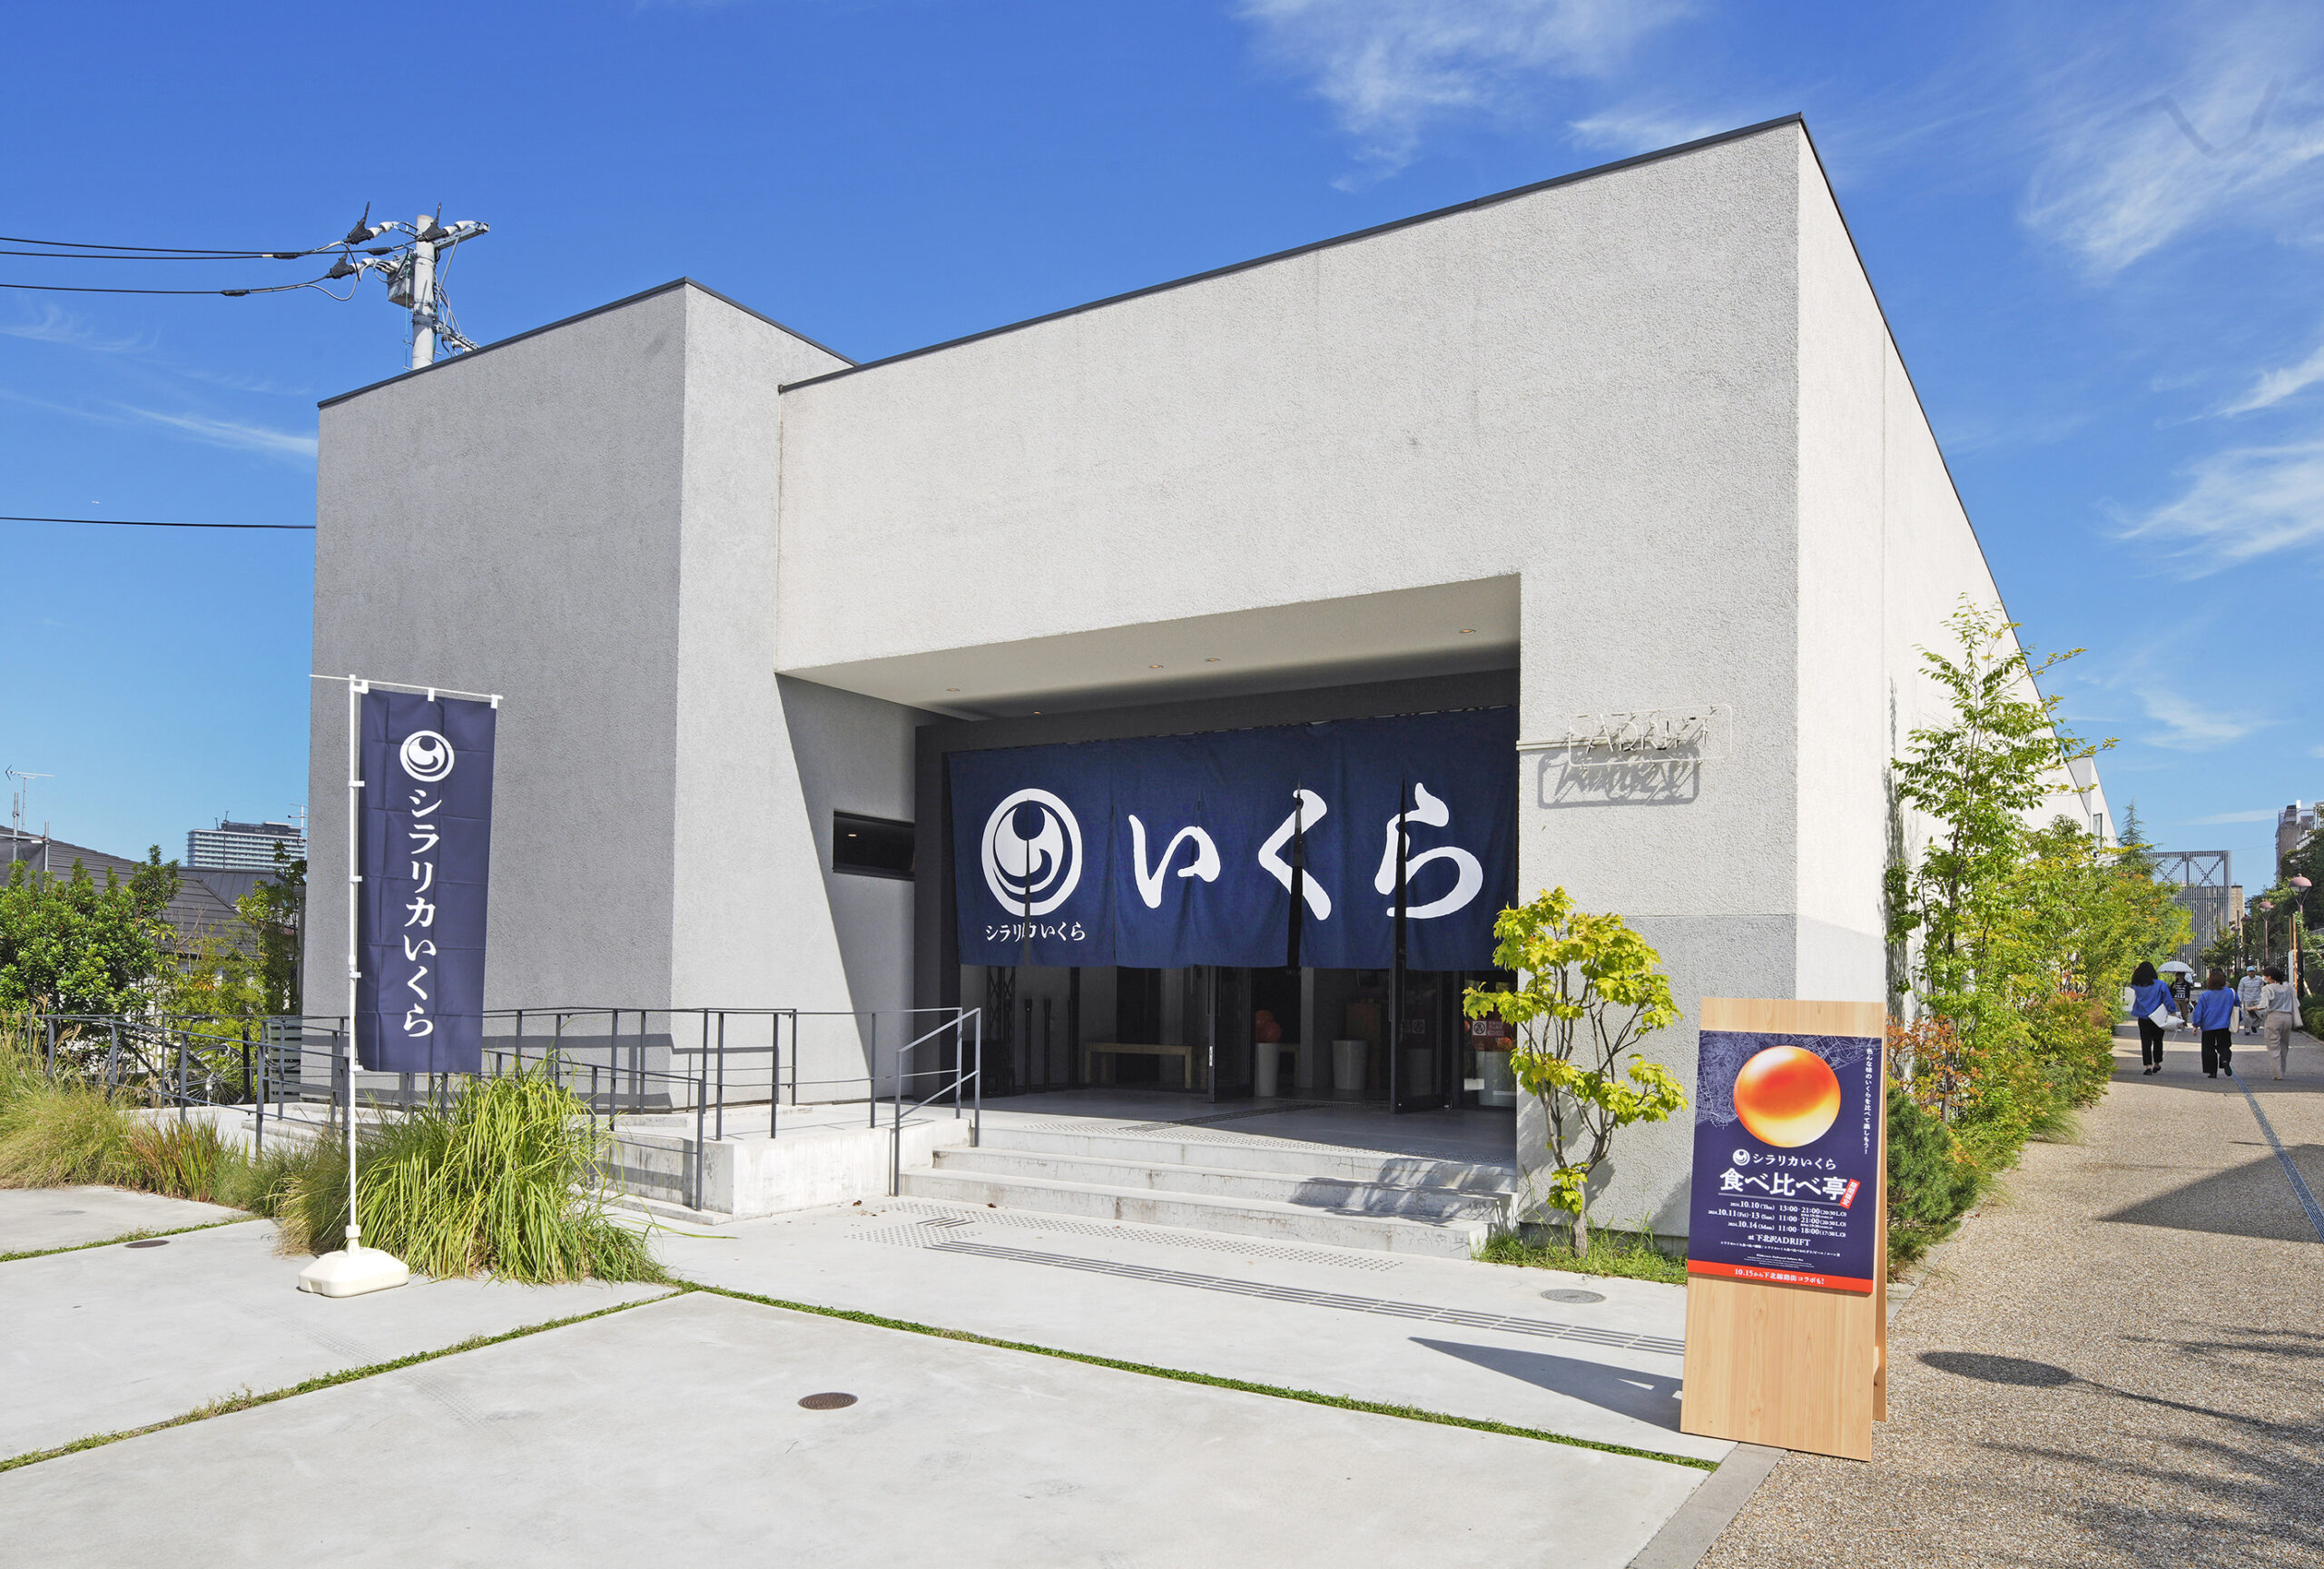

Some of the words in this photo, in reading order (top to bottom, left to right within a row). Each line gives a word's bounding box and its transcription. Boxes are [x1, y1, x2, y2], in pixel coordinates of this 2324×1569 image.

[1570, 713, 1714, 754] ADRIFT
[1128, 782, 1484, 922] いくら
[403, 788, 443, 1038] シラリカいくら
[985, 921, 1086, 942] シラリカいくら
[1752, 1153, 1837, 1170] シラリカいくら
[1719, 1167, 1847, 1200] 食べ比べ亭
